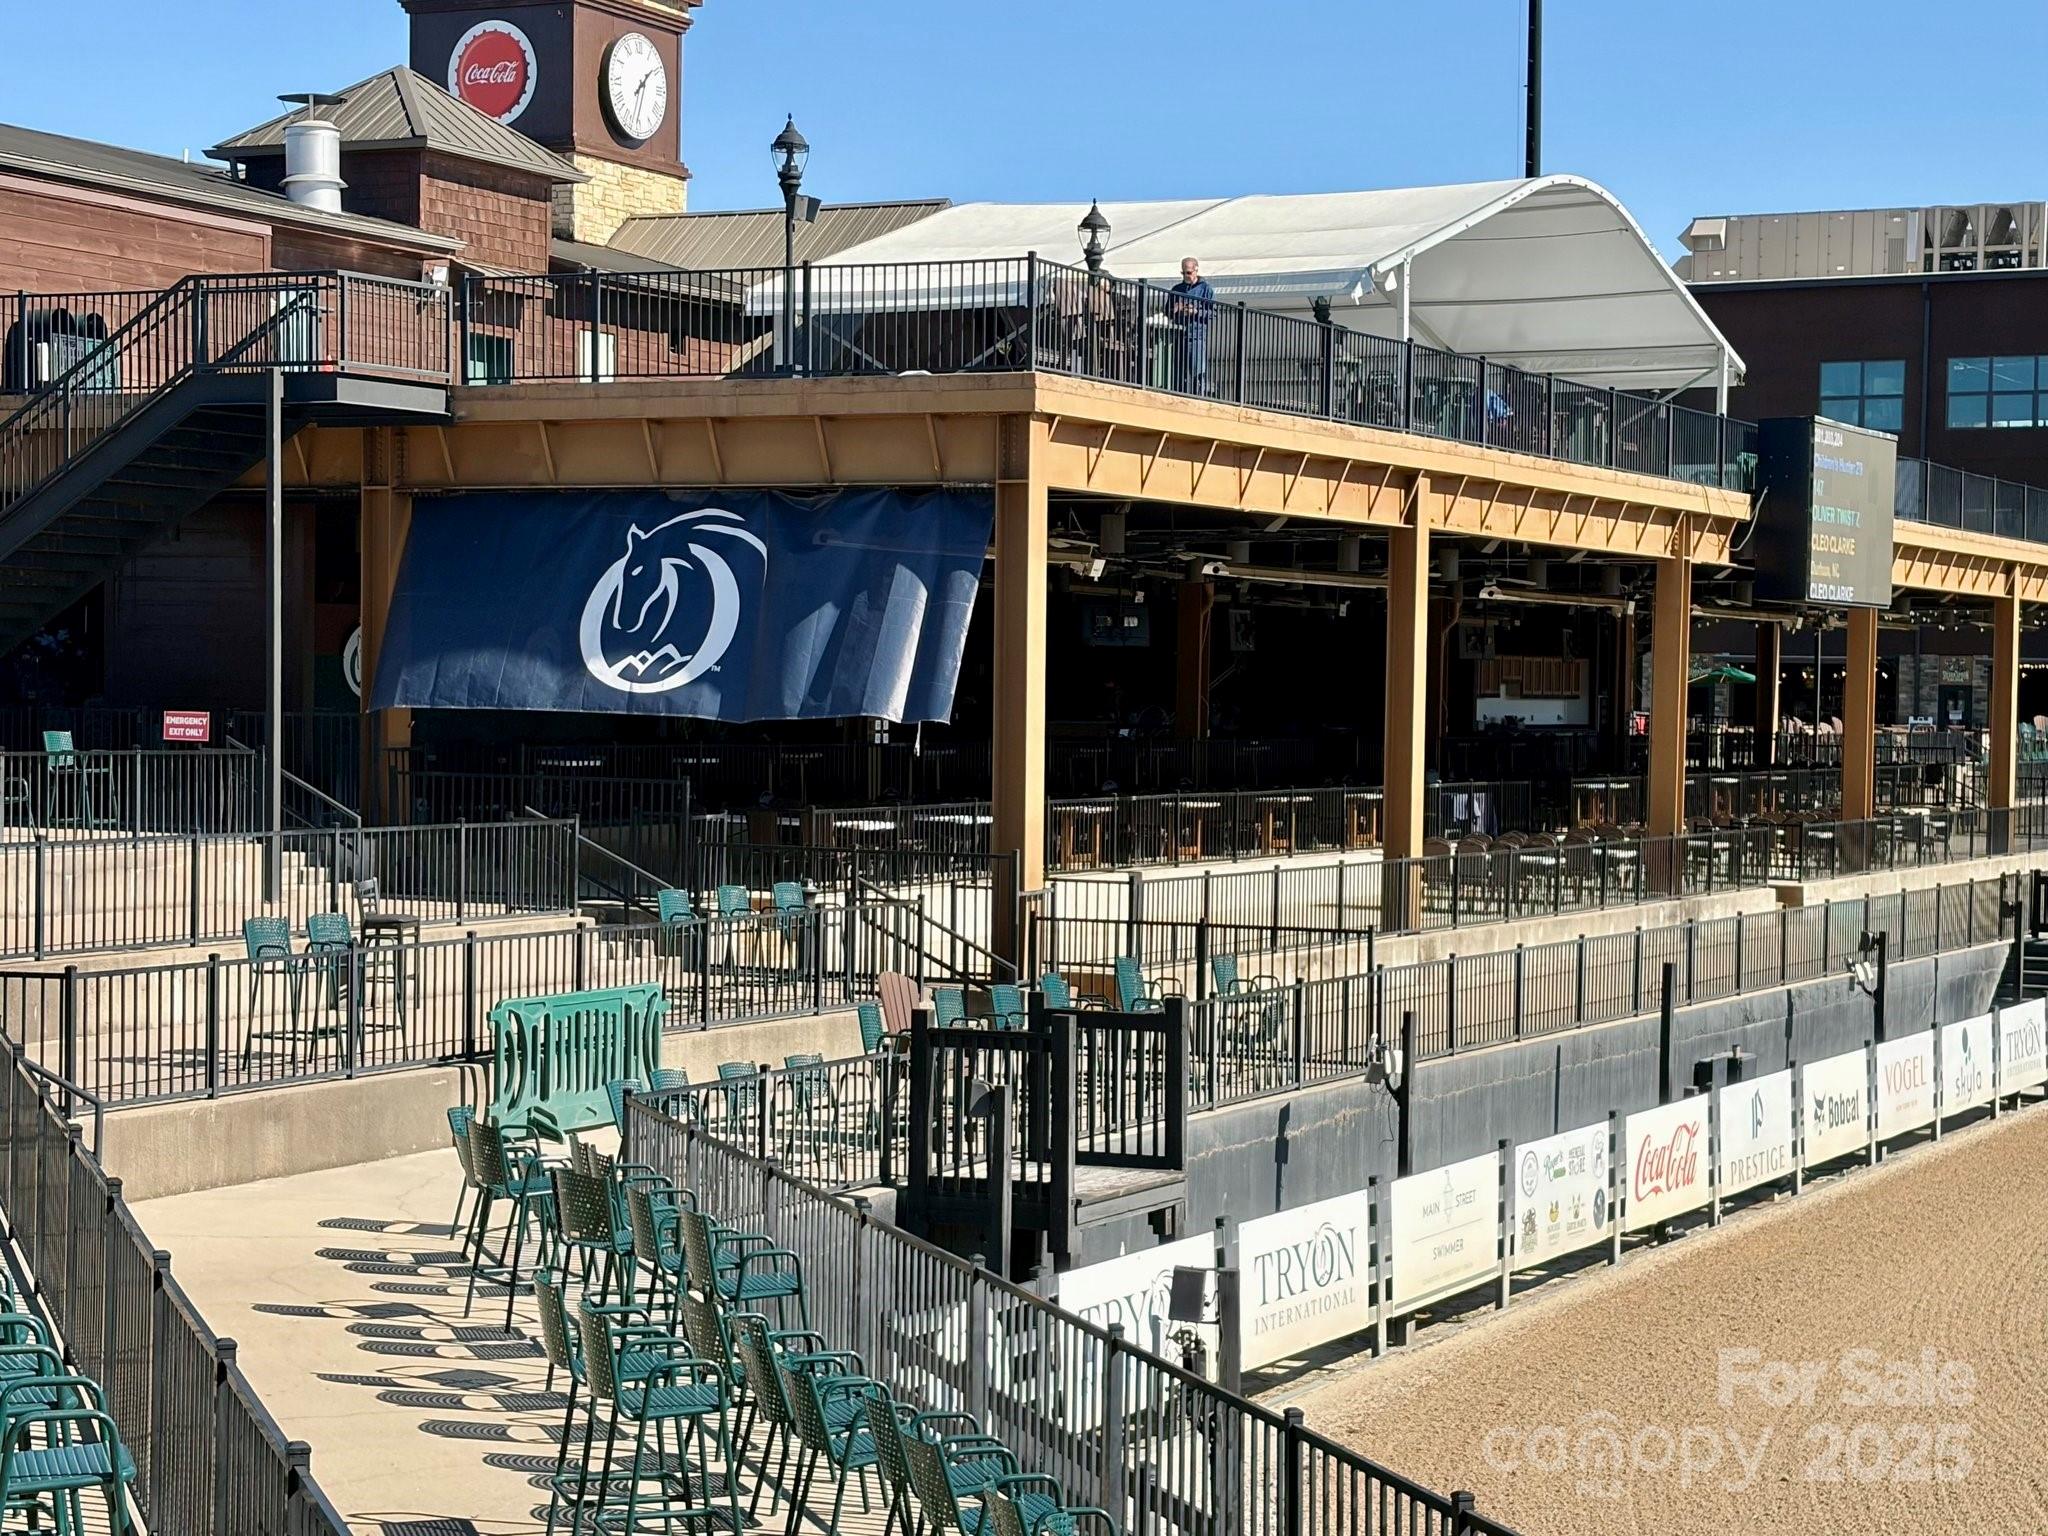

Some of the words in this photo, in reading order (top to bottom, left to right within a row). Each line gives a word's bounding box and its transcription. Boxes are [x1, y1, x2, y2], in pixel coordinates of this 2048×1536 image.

[465, 61, 519, 85] Coca-Cola
[1813, 505, 1836, 524] OLIVER
[1837, 507, 1855, 527] TWIST
[1812, 533, 1829, 552] CLEO
[1830, 536, 1856, 556] CLARKE
[1810, 582, 1828, 600] CLEO
[1829, 584, 1855, 602] CLARKE
[166, 716, 208, 726] EMERGENCY
[169, 727, 185, 736] EXIT
[185, 728, 203, 737] ONLY
[2006, 1018, 2042, 1063] TRYON
[1884, 1054, 1927, 1096] VOGEL
[1955, 1061, 1982, 1103] skyla
[1828, 1088, 1860, 1129] Bobcat
[1635, 1120, 1701, 1203] Coca-Cola
[1730, 1144, 1785, 1186] PRESTIGE
[1422, 1201, 1441, 1218] MAIN
[1455, 1189, 1477, 1208] STREET
[1254, 1221, 1358, 1307] TRYON
[1432, 1238, 1465, 1261] SWIMMER
[1254, 1287, 1356, 1336] INTERNATIONAL
